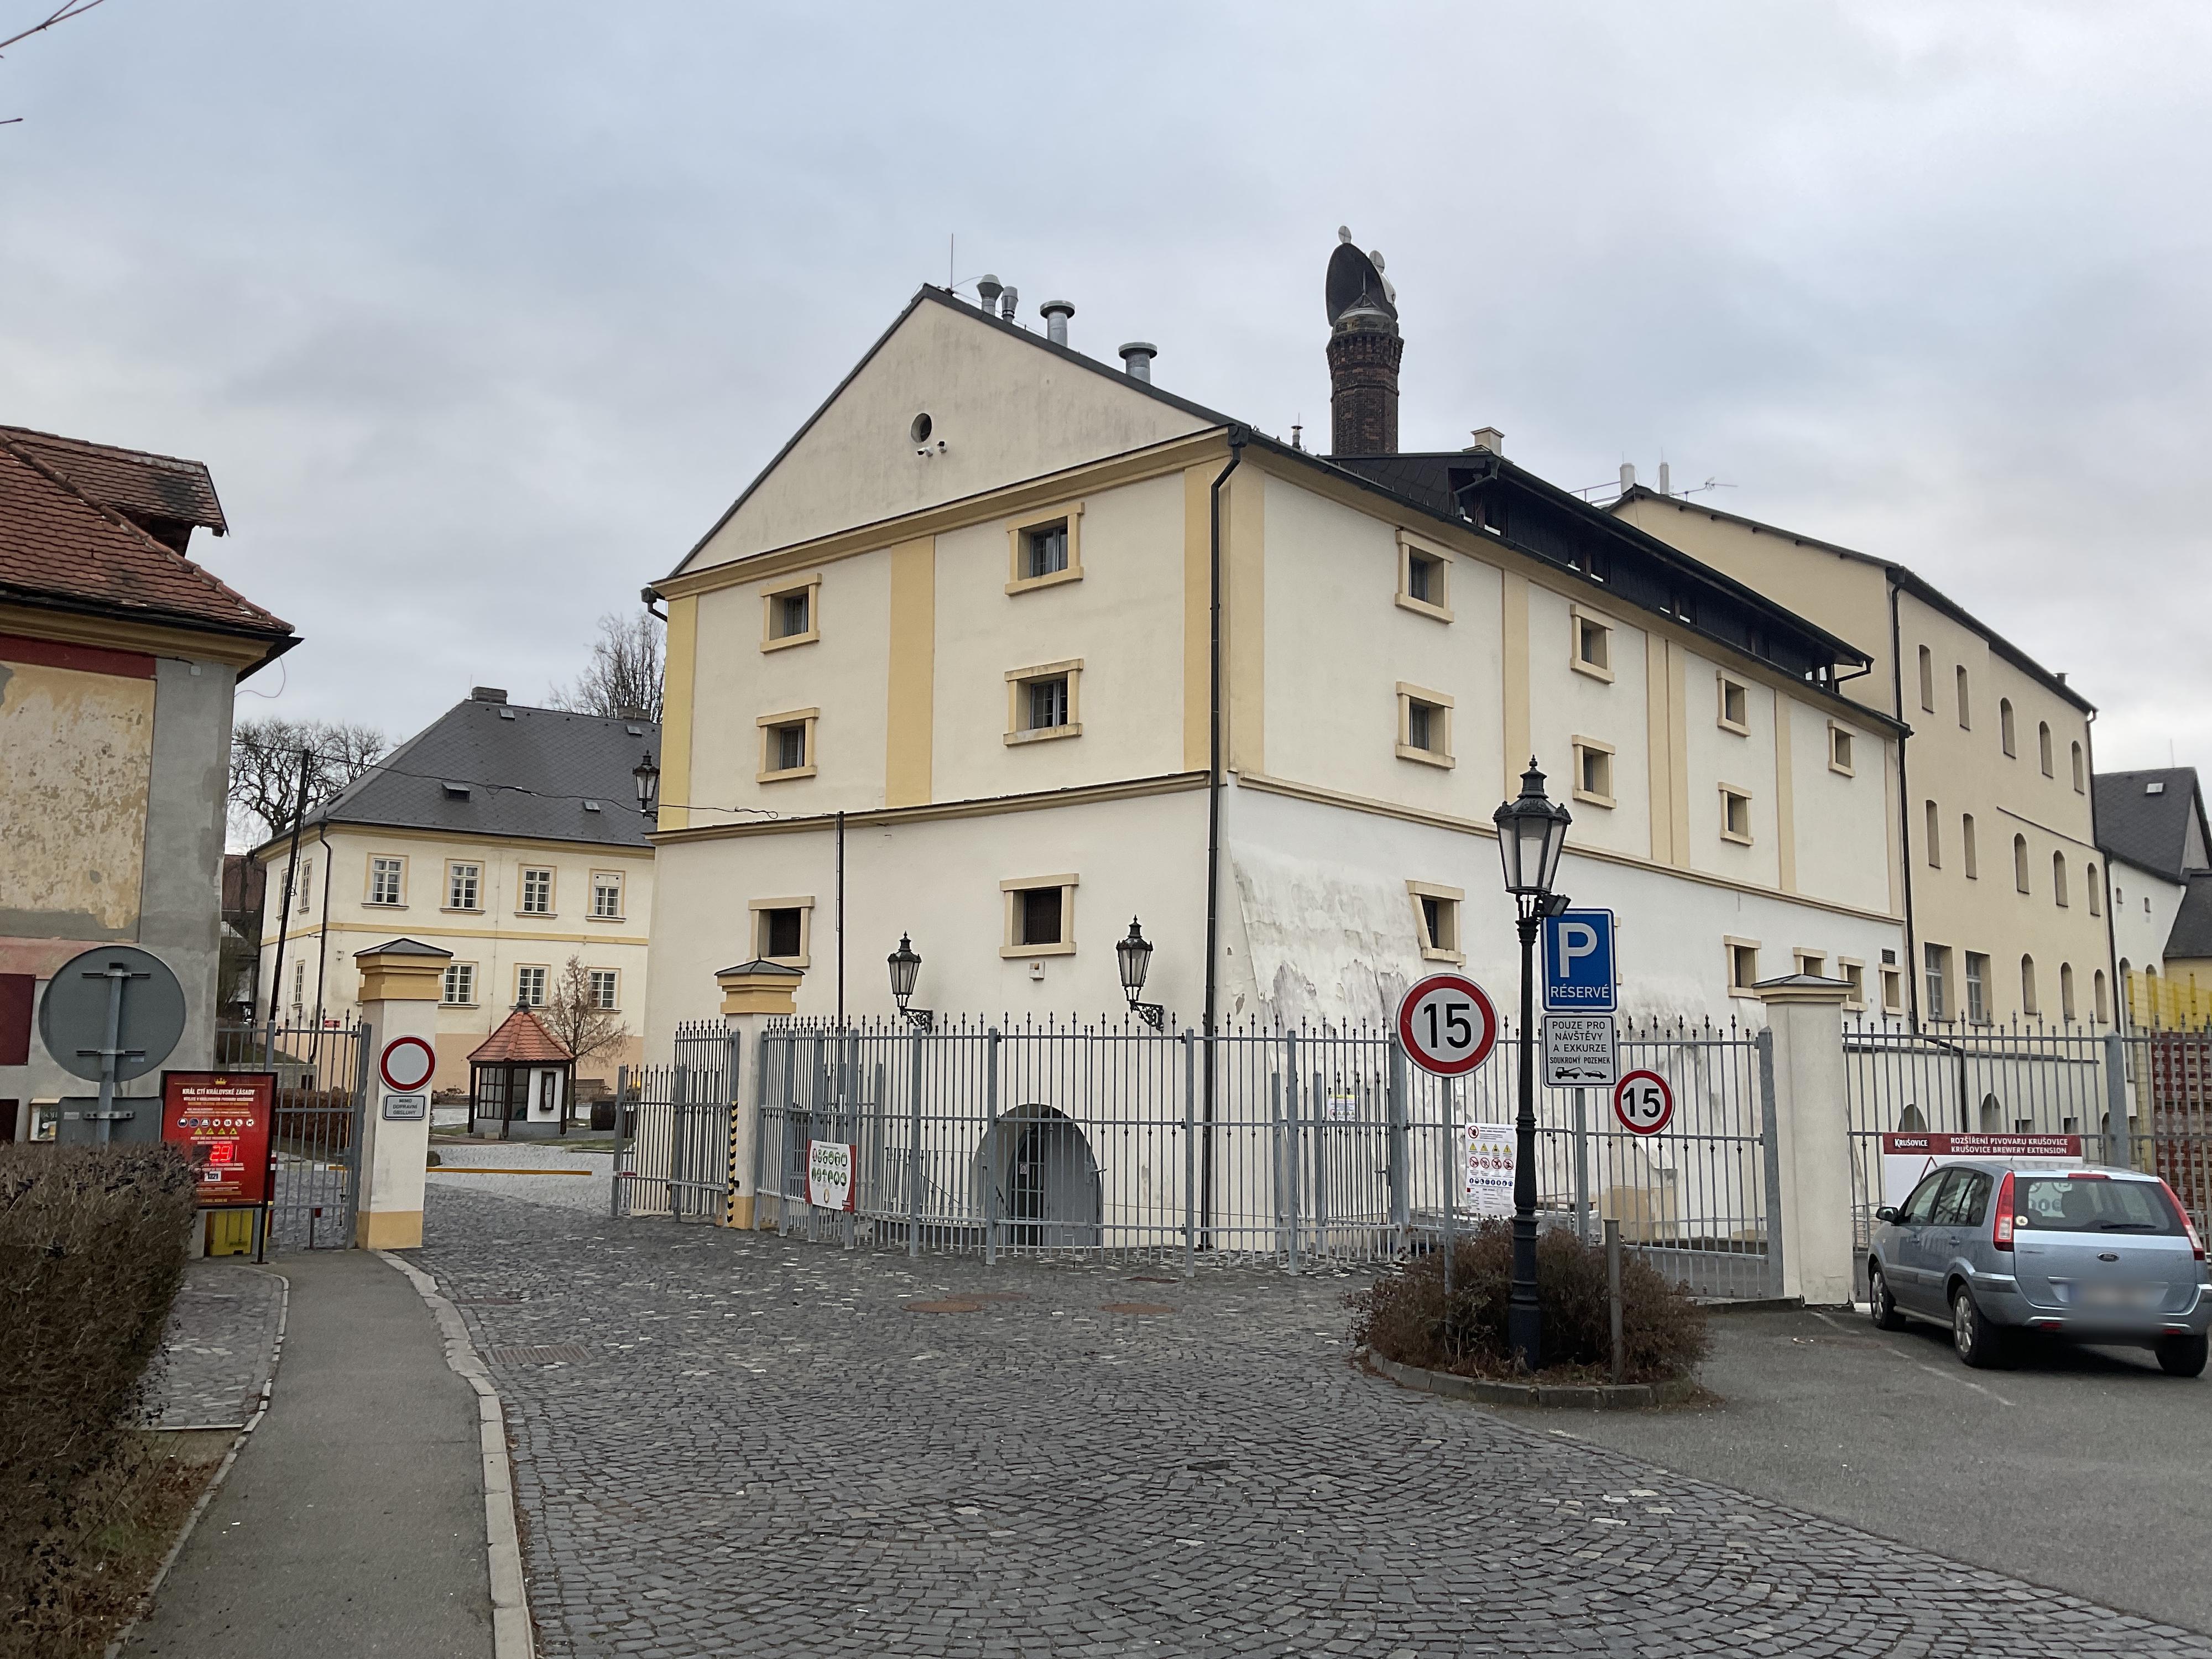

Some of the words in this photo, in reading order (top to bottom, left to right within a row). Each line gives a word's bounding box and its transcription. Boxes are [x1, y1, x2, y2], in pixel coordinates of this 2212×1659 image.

[1558, 922, 1598, 978] P
[1551, 983, 1610, 998] RÉSERVÉ
[1423, 1003, 1472, 1048] 15
[1552, 1021, 1583, 1029] POUZE
[1555, 1030, 1603, 1041] NÁVŠTĚVY
[1564, 1044, 1606, 1052] EXKURZE
[1550, 1055, 1580, 1064] SOUKROMÝ
[1623, 1087, 1661, 1118] 15
[1895, 1138, 1928, 1148] KRUŠOVICE
[1950, 1136, 1989, 1145] ROZŠÍŘENÍ
[2028, 1137, 2068, 1146] KRUŠOVICE
[209, 1145, 231, 1161] 29
[1951, 1145, 1991, 1154] KRUŠOVICE
